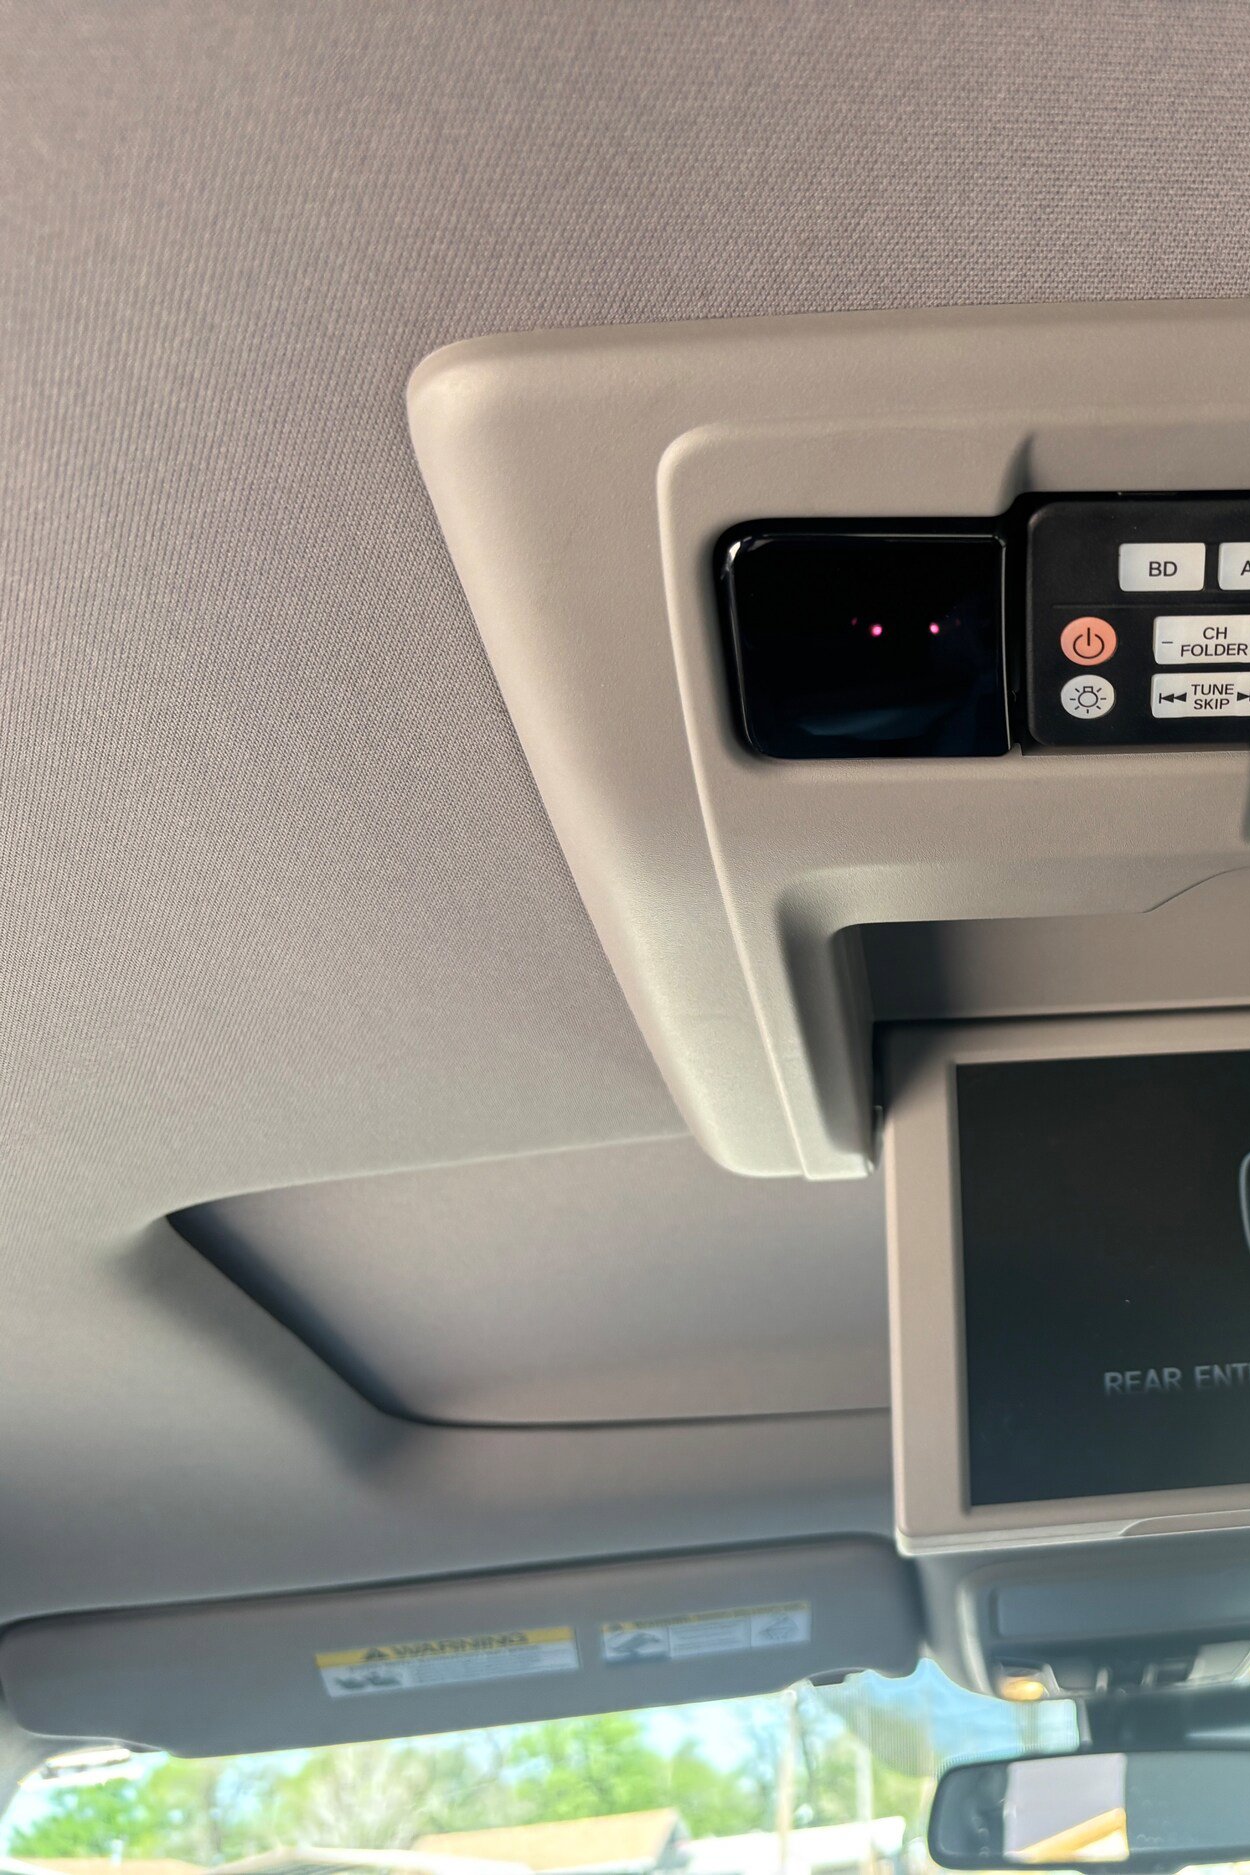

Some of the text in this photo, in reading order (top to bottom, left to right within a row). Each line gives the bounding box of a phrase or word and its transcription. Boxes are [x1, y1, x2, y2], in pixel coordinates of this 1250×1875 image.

[1147, 560, 1178, 578] BD
[1202, 626, 1228, 641] CH
[1180, 642, 1249, 658] FOLDER
[1191, 682, 1235, 697] TUNE
[1193, 698, 1231, 711] SKIP
[1103, 1367, 1183, 1396] REAR
